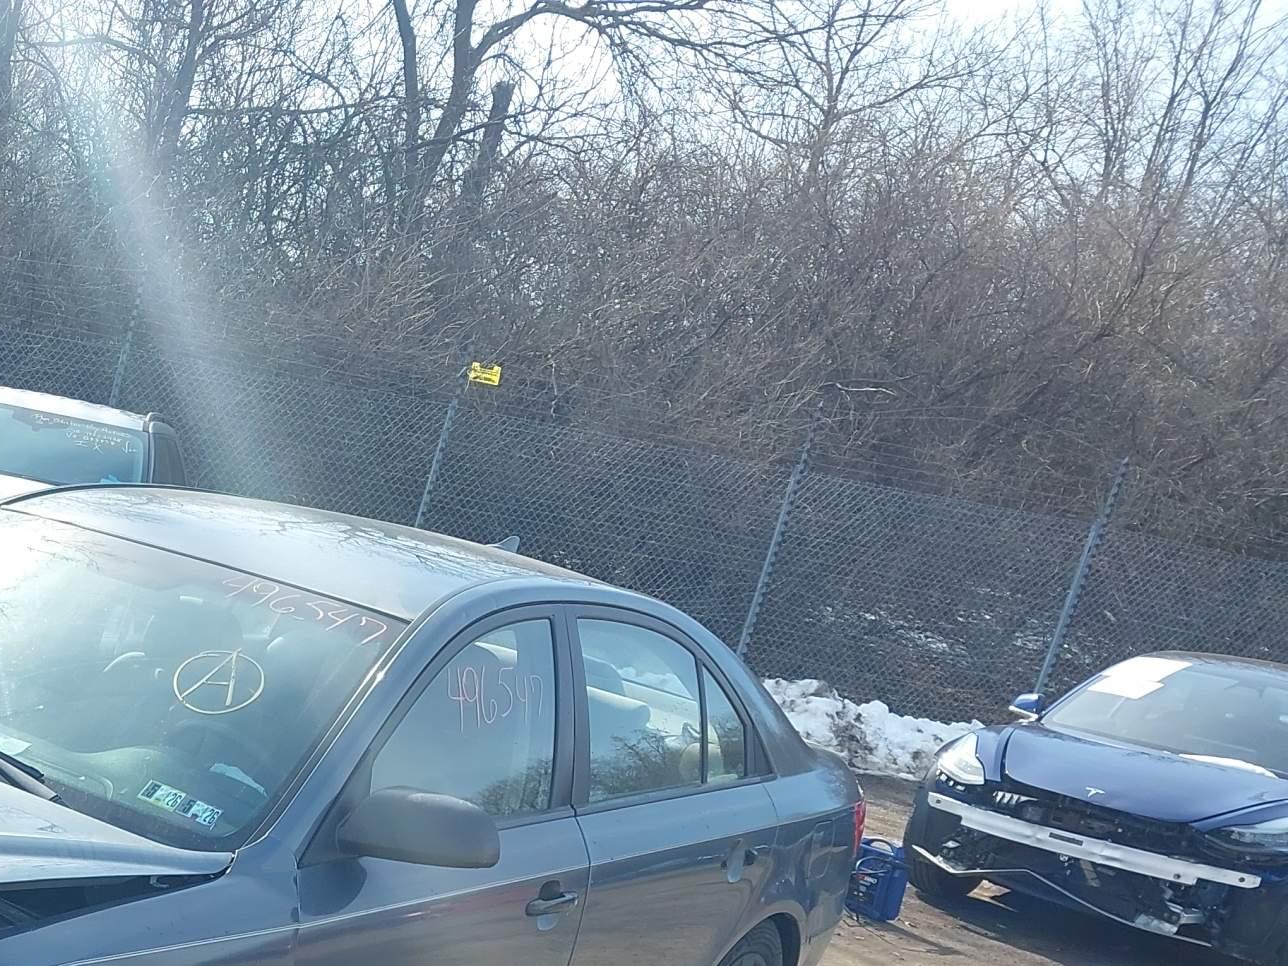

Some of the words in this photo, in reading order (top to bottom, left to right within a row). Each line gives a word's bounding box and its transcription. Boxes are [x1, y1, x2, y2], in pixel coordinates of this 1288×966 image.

[178, 647, 244, 707] A
[446, 663, 544, 735] 496547
[183, 800, 197, 814] 5
